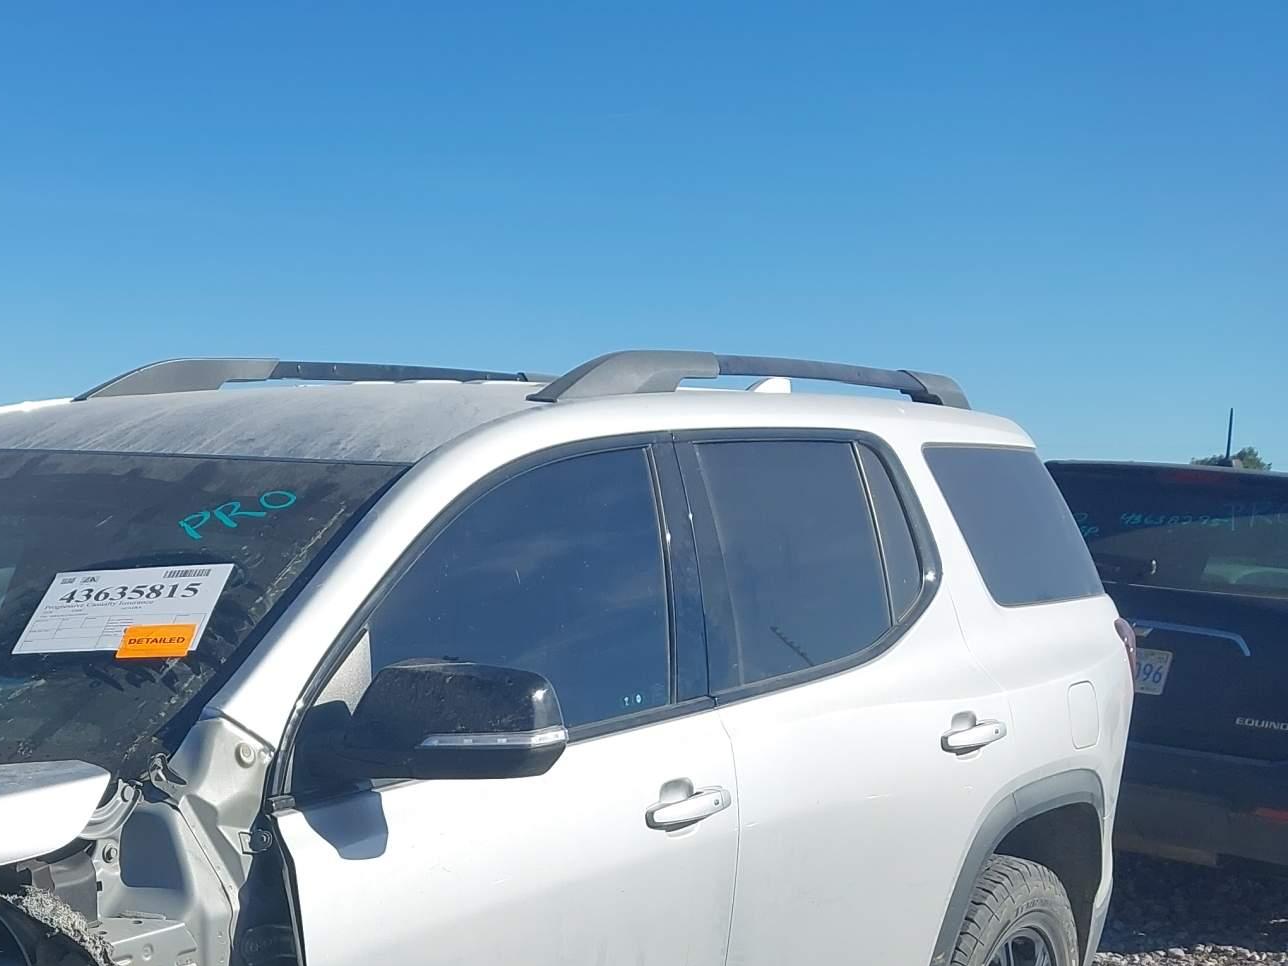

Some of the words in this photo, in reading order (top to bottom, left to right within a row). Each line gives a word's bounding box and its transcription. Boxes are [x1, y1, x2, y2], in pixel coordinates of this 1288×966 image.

[178, 490, 297, 540] PRO
[58, 582, 201, 603] 43635815
[128, 637, 185, 645] DETAILED
